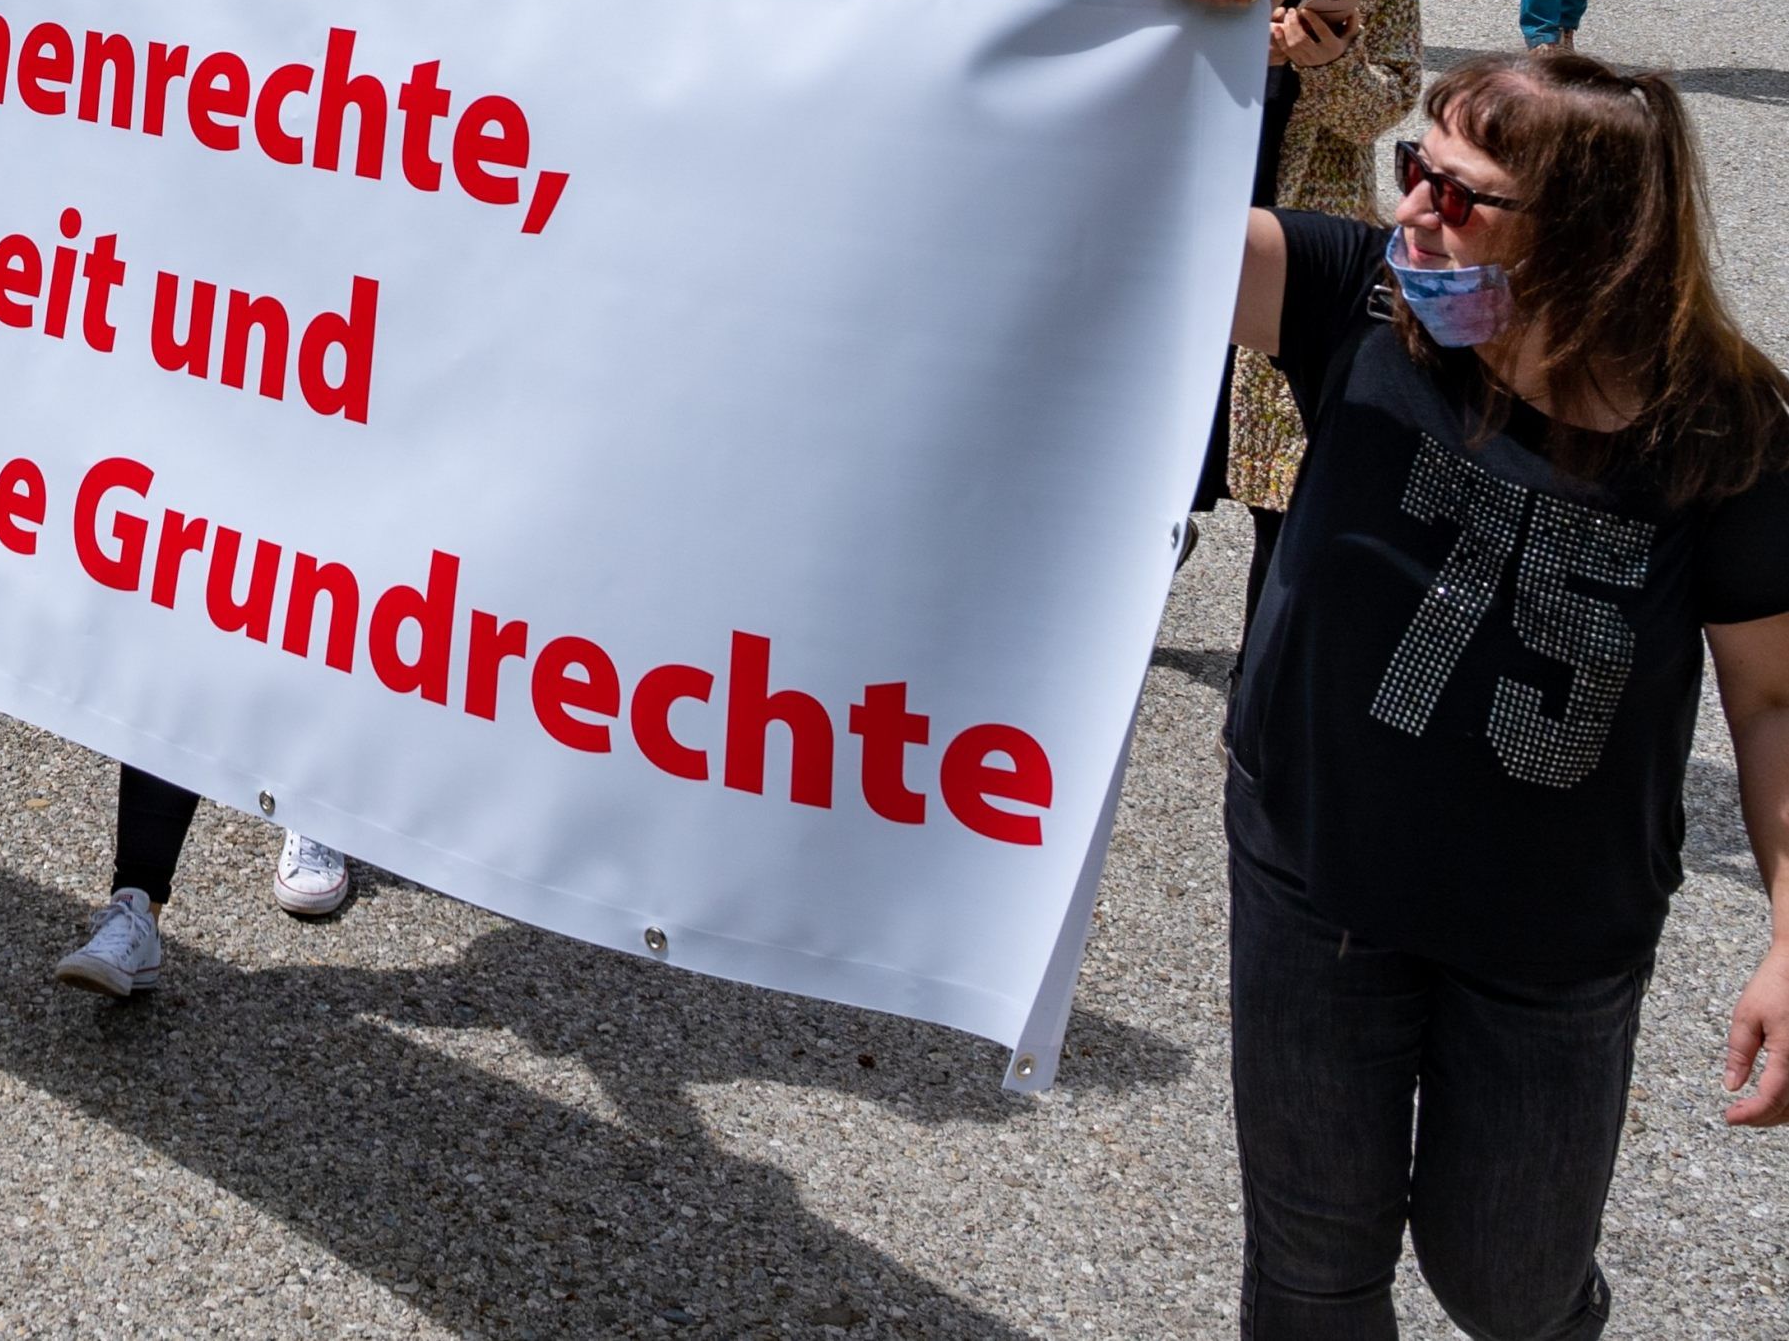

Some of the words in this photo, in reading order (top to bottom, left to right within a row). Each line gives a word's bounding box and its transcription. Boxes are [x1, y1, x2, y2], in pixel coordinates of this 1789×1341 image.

[151, 272, 378, 424] und
[74, 458, 1052, 846] Grundrechte
[1370, 431, 1658, 789] 75
